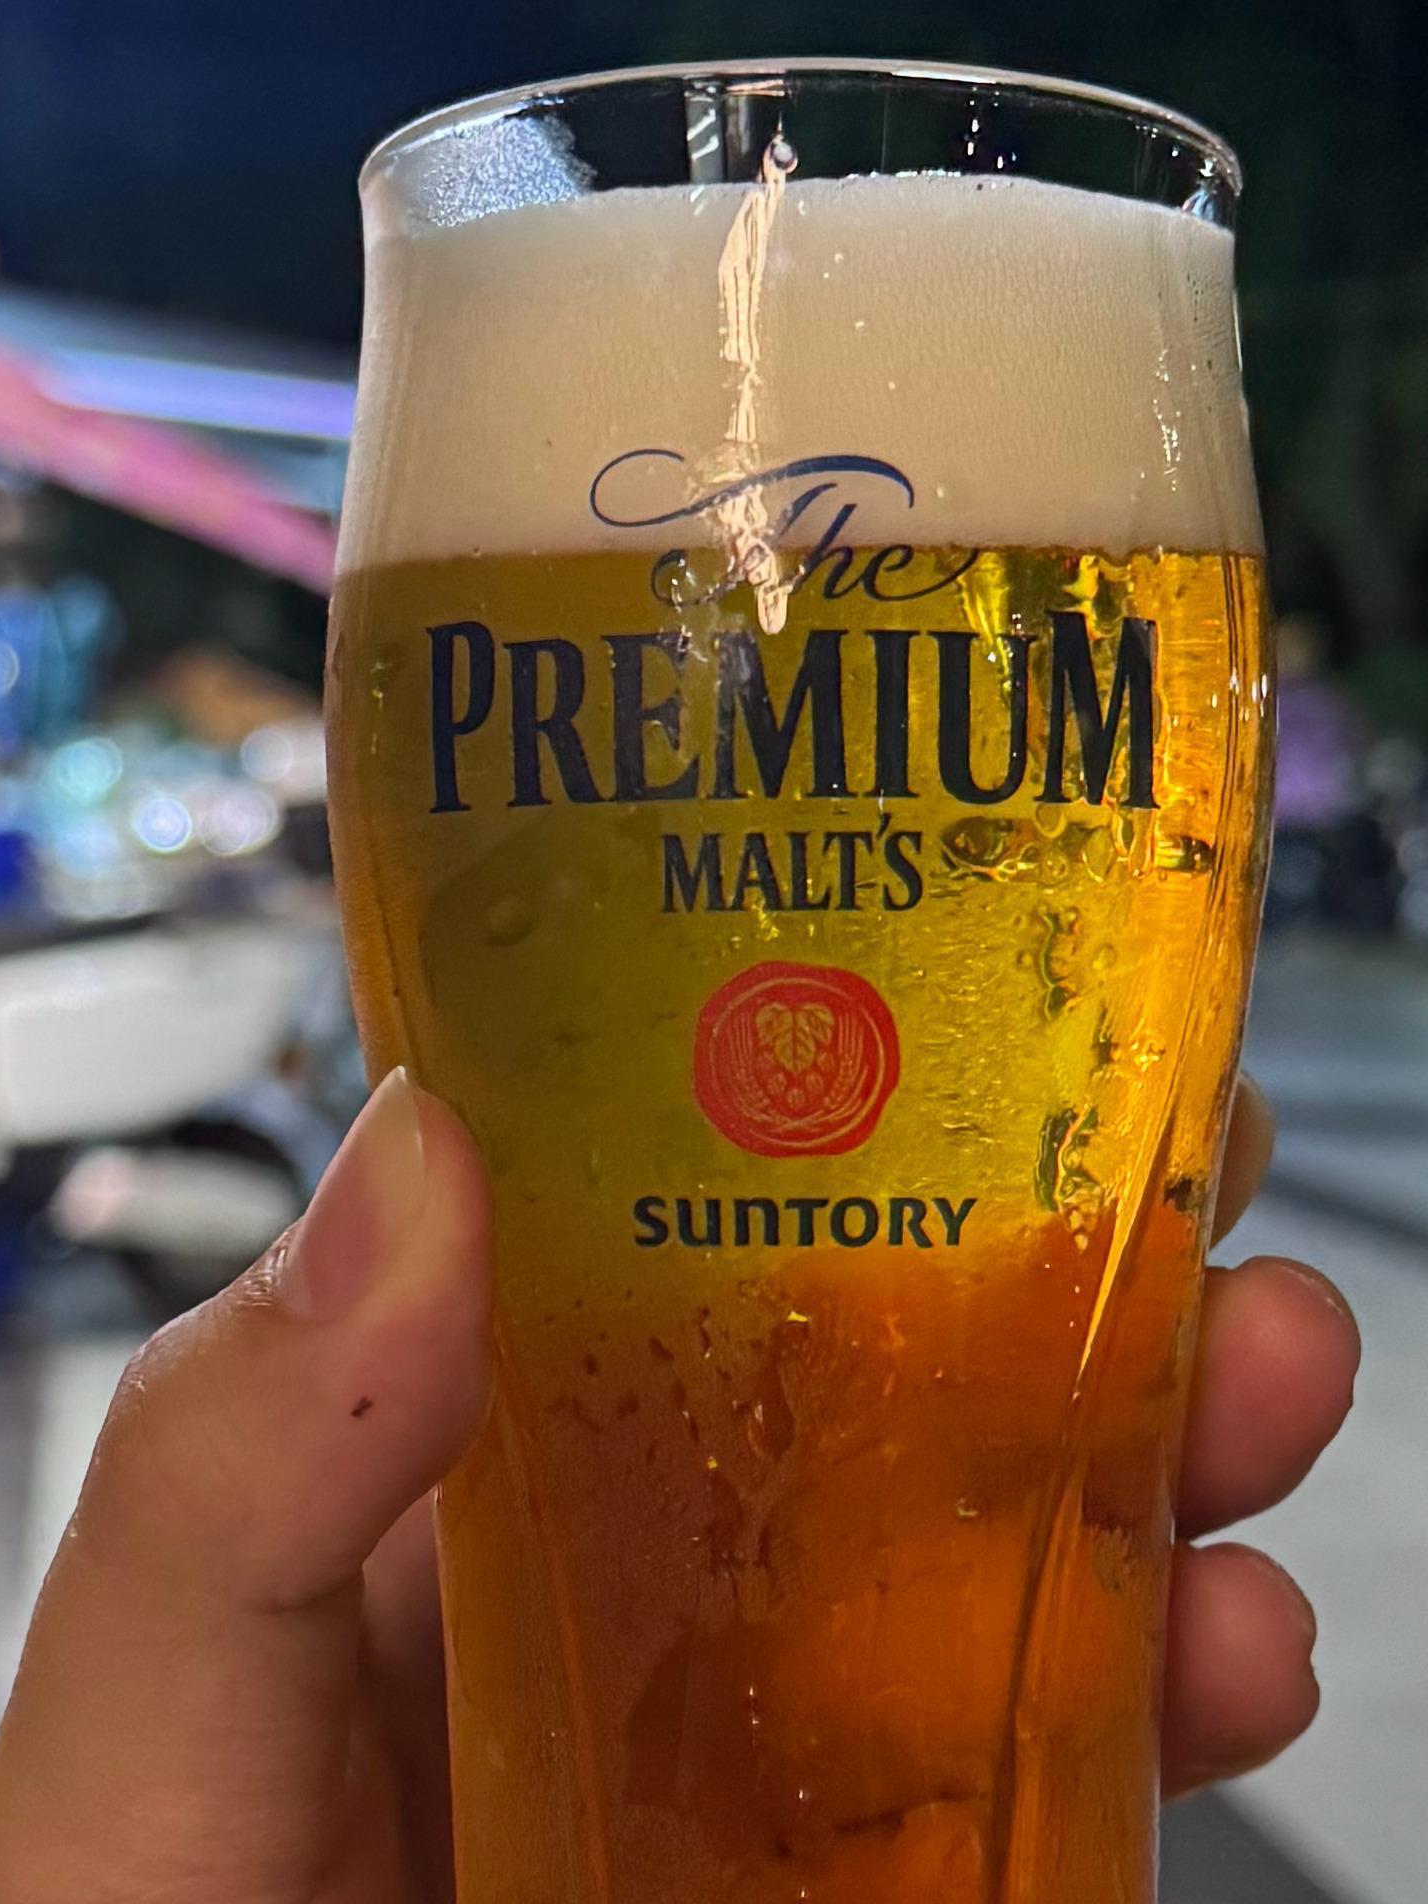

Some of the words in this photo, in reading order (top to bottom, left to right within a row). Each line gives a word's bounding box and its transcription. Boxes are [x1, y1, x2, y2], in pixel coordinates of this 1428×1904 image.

[589, 448, 980, 608] The
[425, 610, 1160, 815] PREMIUM
[661, 813, 924, 914] MALT'S
[632, 1195, 977, 1248] SUNTORY
